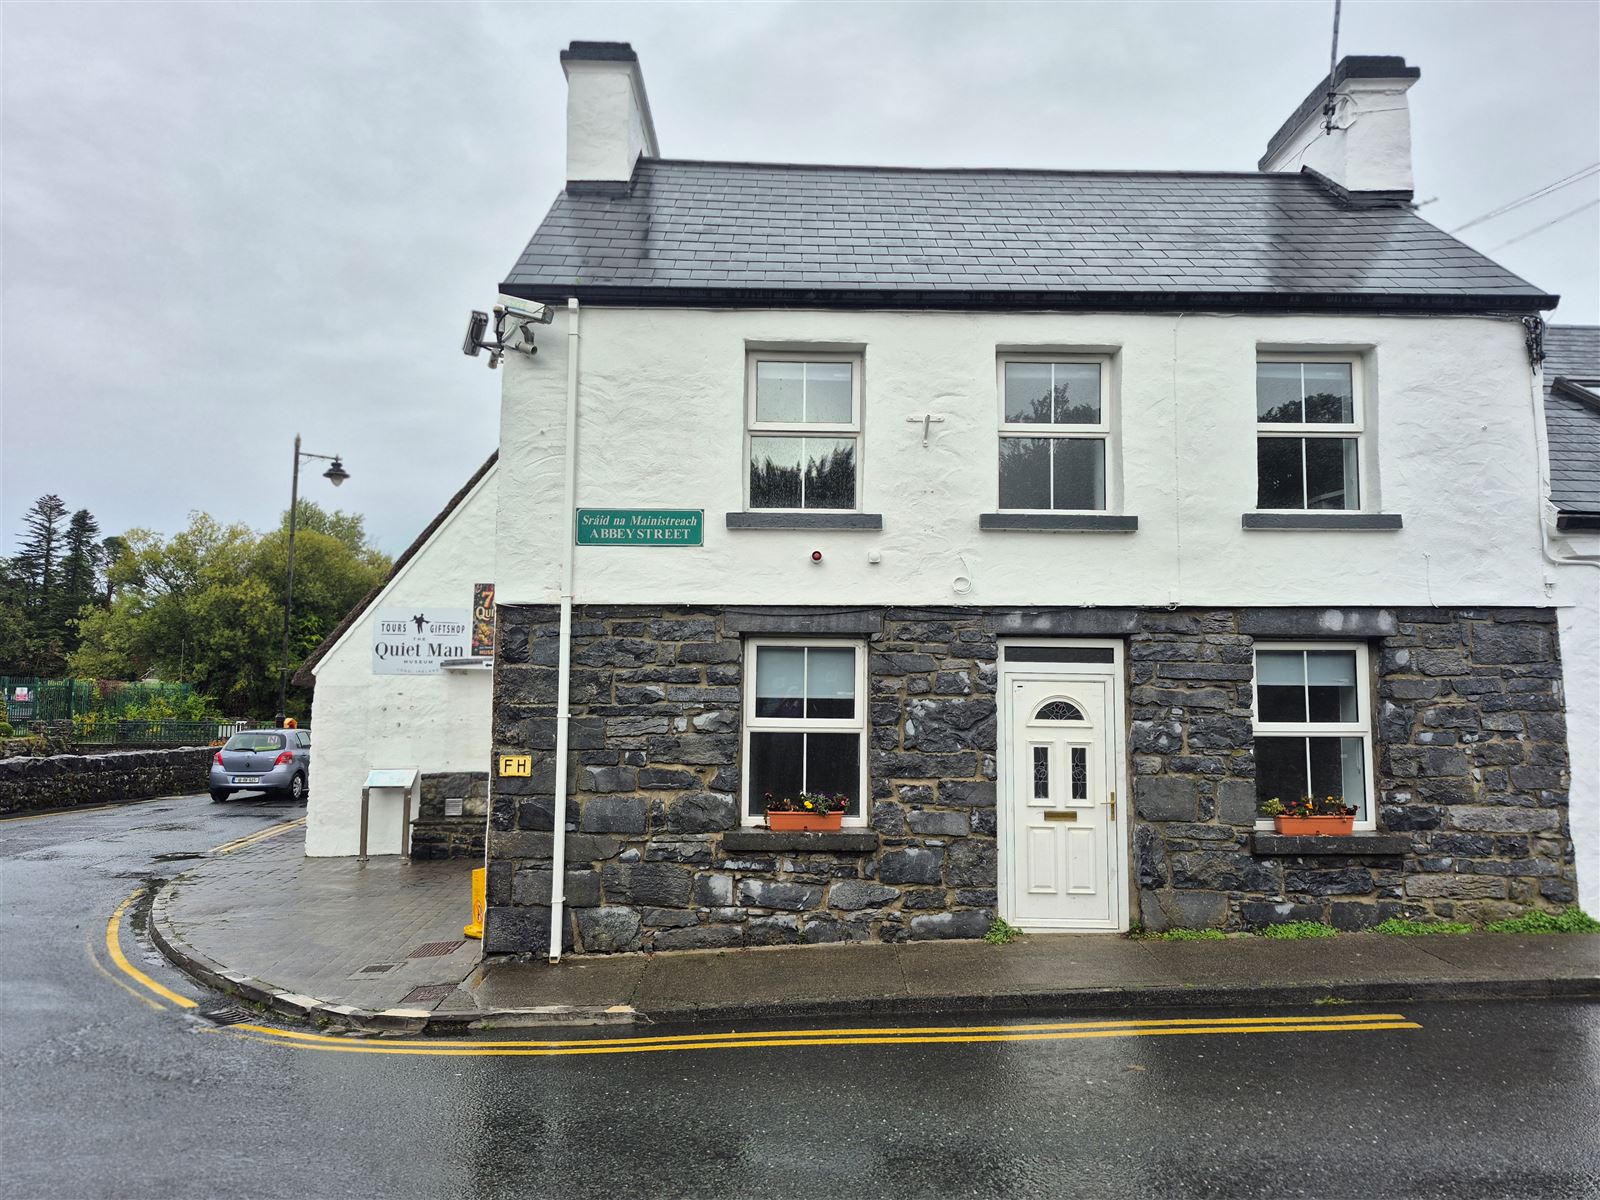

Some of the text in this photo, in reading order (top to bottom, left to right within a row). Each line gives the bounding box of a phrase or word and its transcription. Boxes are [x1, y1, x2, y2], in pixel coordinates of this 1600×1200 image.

[581, 514, 697, 527] Sráid na Mainistreach
[589, 528, 691, 540] ABBEY STREET
[381, 623, 407, 633] TOURS
[429, 624, 466, 634] GIFTSHOP
[375, 641, 464, 661] Quiet Man
